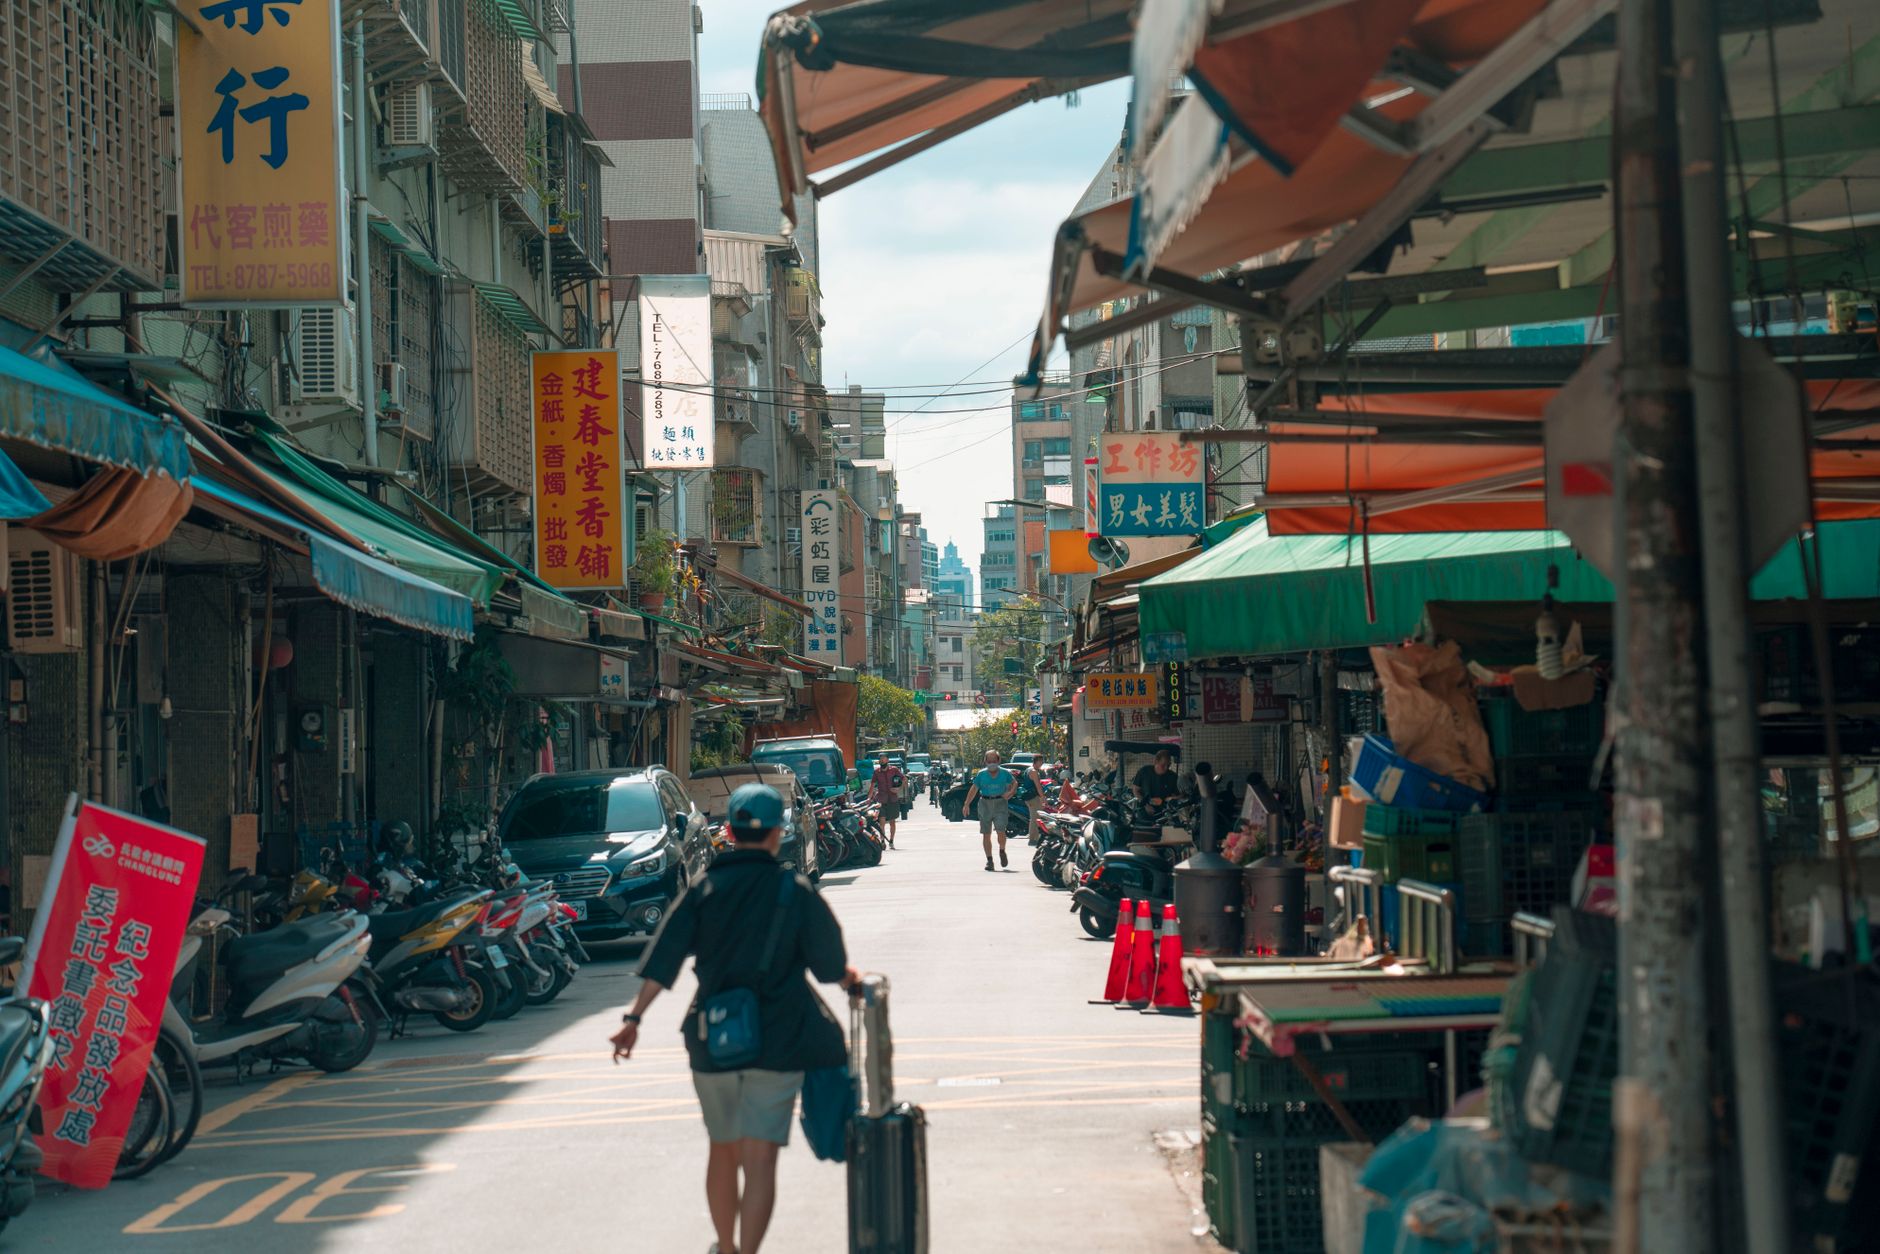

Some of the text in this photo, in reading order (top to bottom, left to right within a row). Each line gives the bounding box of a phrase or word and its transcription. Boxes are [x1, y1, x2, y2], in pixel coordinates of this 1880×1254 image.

[190, 202, 329, 250] 代客煎藥
[190, 262, 331, 290] TEL:8787-5968
[1104, 439, 1200, 478] 工作坊
[1107, 490, 1199, 529] 男女美髮
[811, 517, 830, 584] 彩虹屋
[807, 590, 836, 602] DVD
[118, 856, 181, 886] CHANGLUNG
[53, 918, 153, 1148] 紀念品發放處
